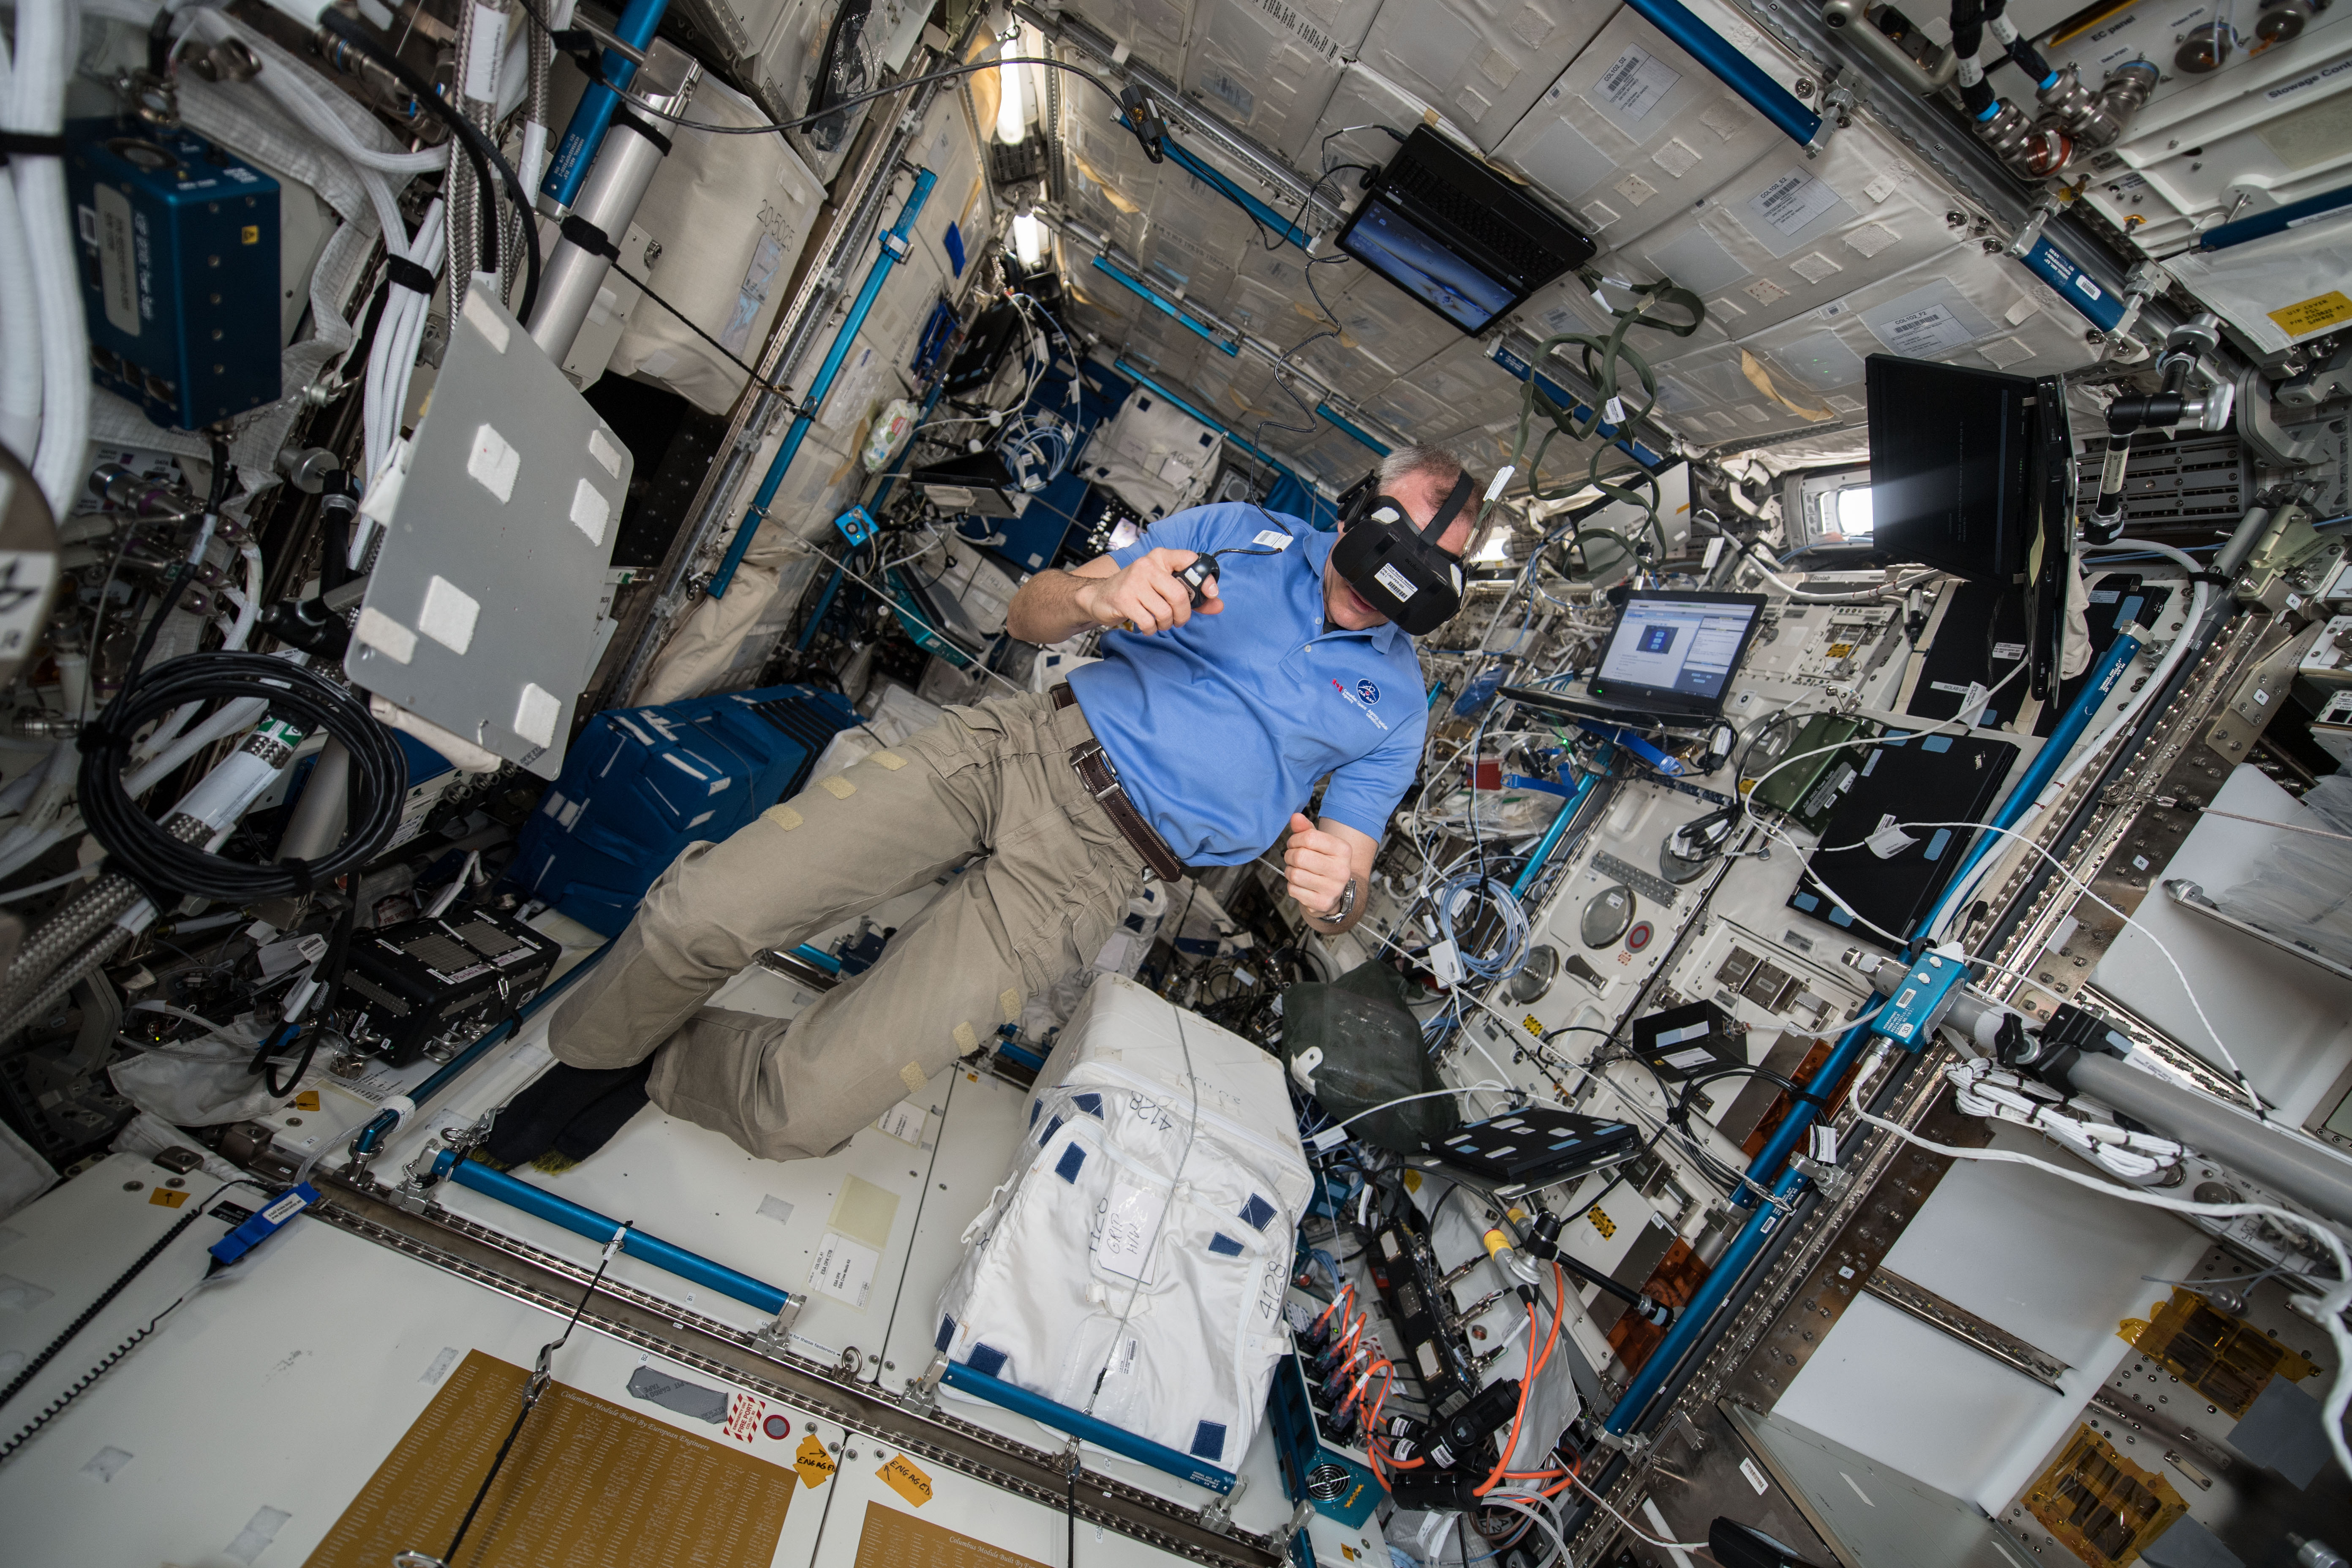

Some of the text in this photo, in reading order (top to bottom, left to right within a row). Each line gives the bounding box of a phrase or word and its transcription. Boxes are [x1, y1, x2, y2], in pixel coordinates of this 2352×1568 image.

[1769, 3, 1778, 11] D
[2091, 15, 2136, 41] EC panel
[2268, 76, 2319, 97] Stowage
[573, 137, 584, 155] HANDRAIL
[2304, 300, 2328, 309] COVER
[1386, 564, 1416, 589] Virtual Reality Headset
[1386, 573, 1404, 588] CAD-PER-002
[2100, 677, 2110, 689] HANDRAIL
[1342, 692, 1353, 703] Agency
[1344, 689, 1367, 710] Canadian Space
[1366, 697, 1375, 705] ASC
[1366, 713, 1380, 729] canadienne
[1368, 709, 1388, 730] Agence spatiale
[1809, 789, 1820, 800] 28VDC
[1818, 780, 1827, 789] Power
[1825, 770, 1836, 780] Supply
[394, 908, 411, 920] PORT
[453, 958, 508, 983] Portable pply
[1073, 968, 1100, 990] 40
[355, 1017, 365, 1032] POWER
[1883, 1011, 1897, 1030] MICROPHONE
[1887, 1012, 1900, 1032] HAND-HELD
[1894, 1023, 1904, 1035] SERIAL
[1130, 1091, 1171, 1130] 4128
[1104, 1213, 1125, 1254] GRIP
[1125, 1223, 1141, 1255] H/W
[814, 1252, 823, 1269] COL1D2_A1
[1259, 1261, 1287, 1320] 4128
[814, 1343, 835, 1355] fasteners
[643, 1384, 659, 1393] TAPE
[650, 1386, 671, 1397] CARGO
[675, 1381, 684, 1389] PIT
[561, 1391, 710, 1451] Columbus Module Built By European Engineers
[733, 1409, 743, 1430] EMERGENCY
[738, 1403, 753, 1433] FIRE PORT
[797, 1456, 837, 1473] ENGAGED
[890, 1461, 931, 1495] ENGAGED
[950, 1536, 976, 1550] Columbus
[977, 1546, 998, 1558] Module
[999, 1554, 1013, 1563] Built
